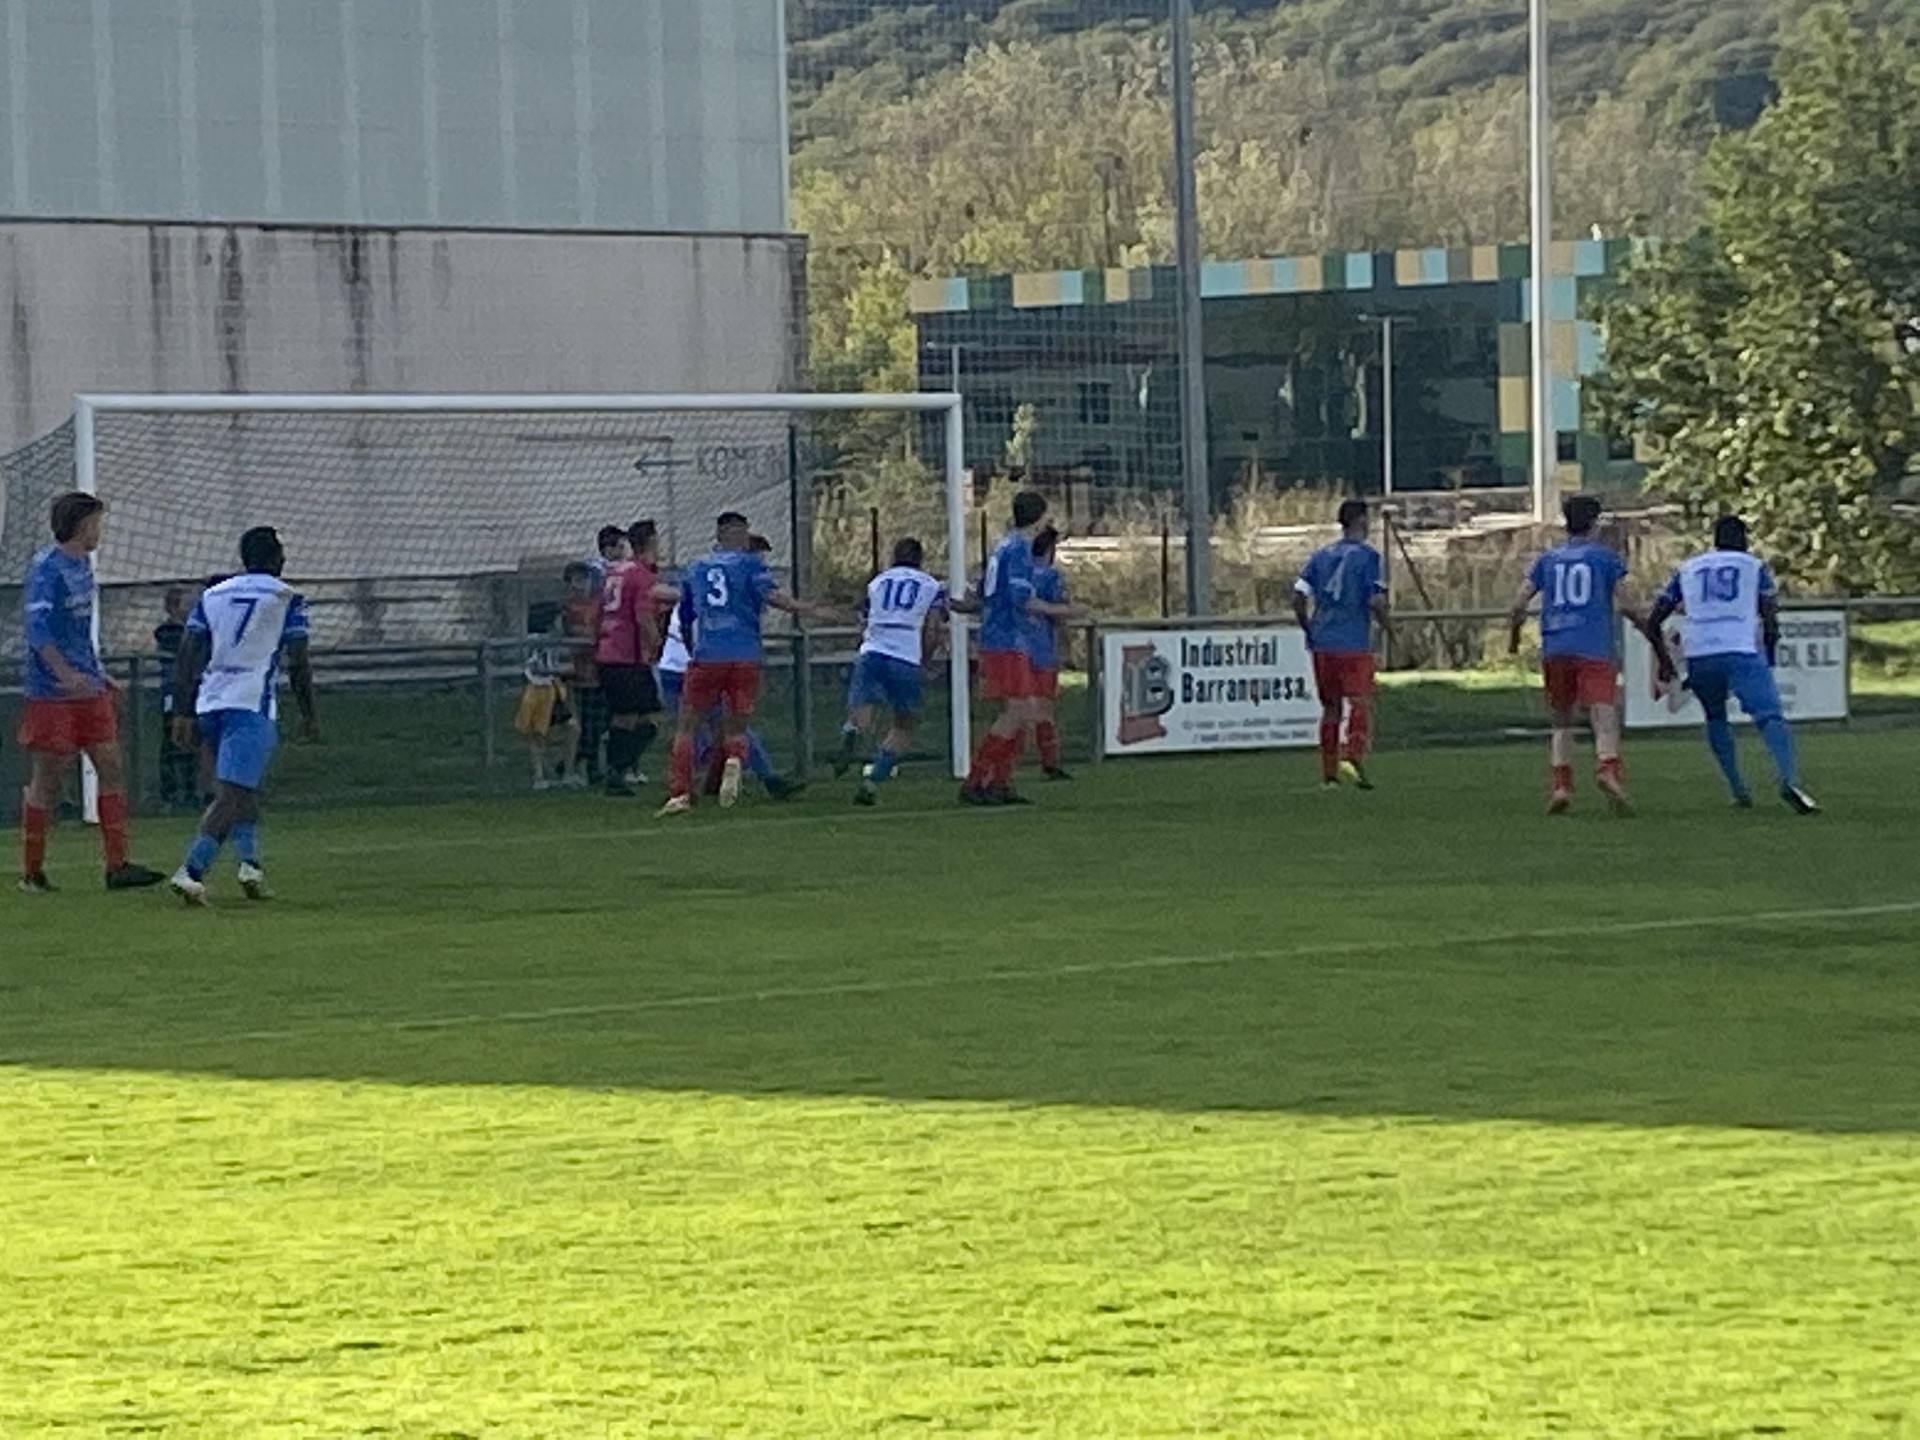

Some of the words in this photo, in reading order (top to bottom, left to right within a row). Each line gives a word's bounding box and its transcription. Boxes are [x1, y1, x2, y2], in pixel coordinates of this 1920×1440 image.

[707, 567, 728, 607] 3
[881, 577, 922, 611] 10
[1553, 563, 1591, 605] 10
[1695, 566, 1740, 602] 19
[229, 597, 259, 647] 7
[1181, 635, 1278, 667] Industrial
